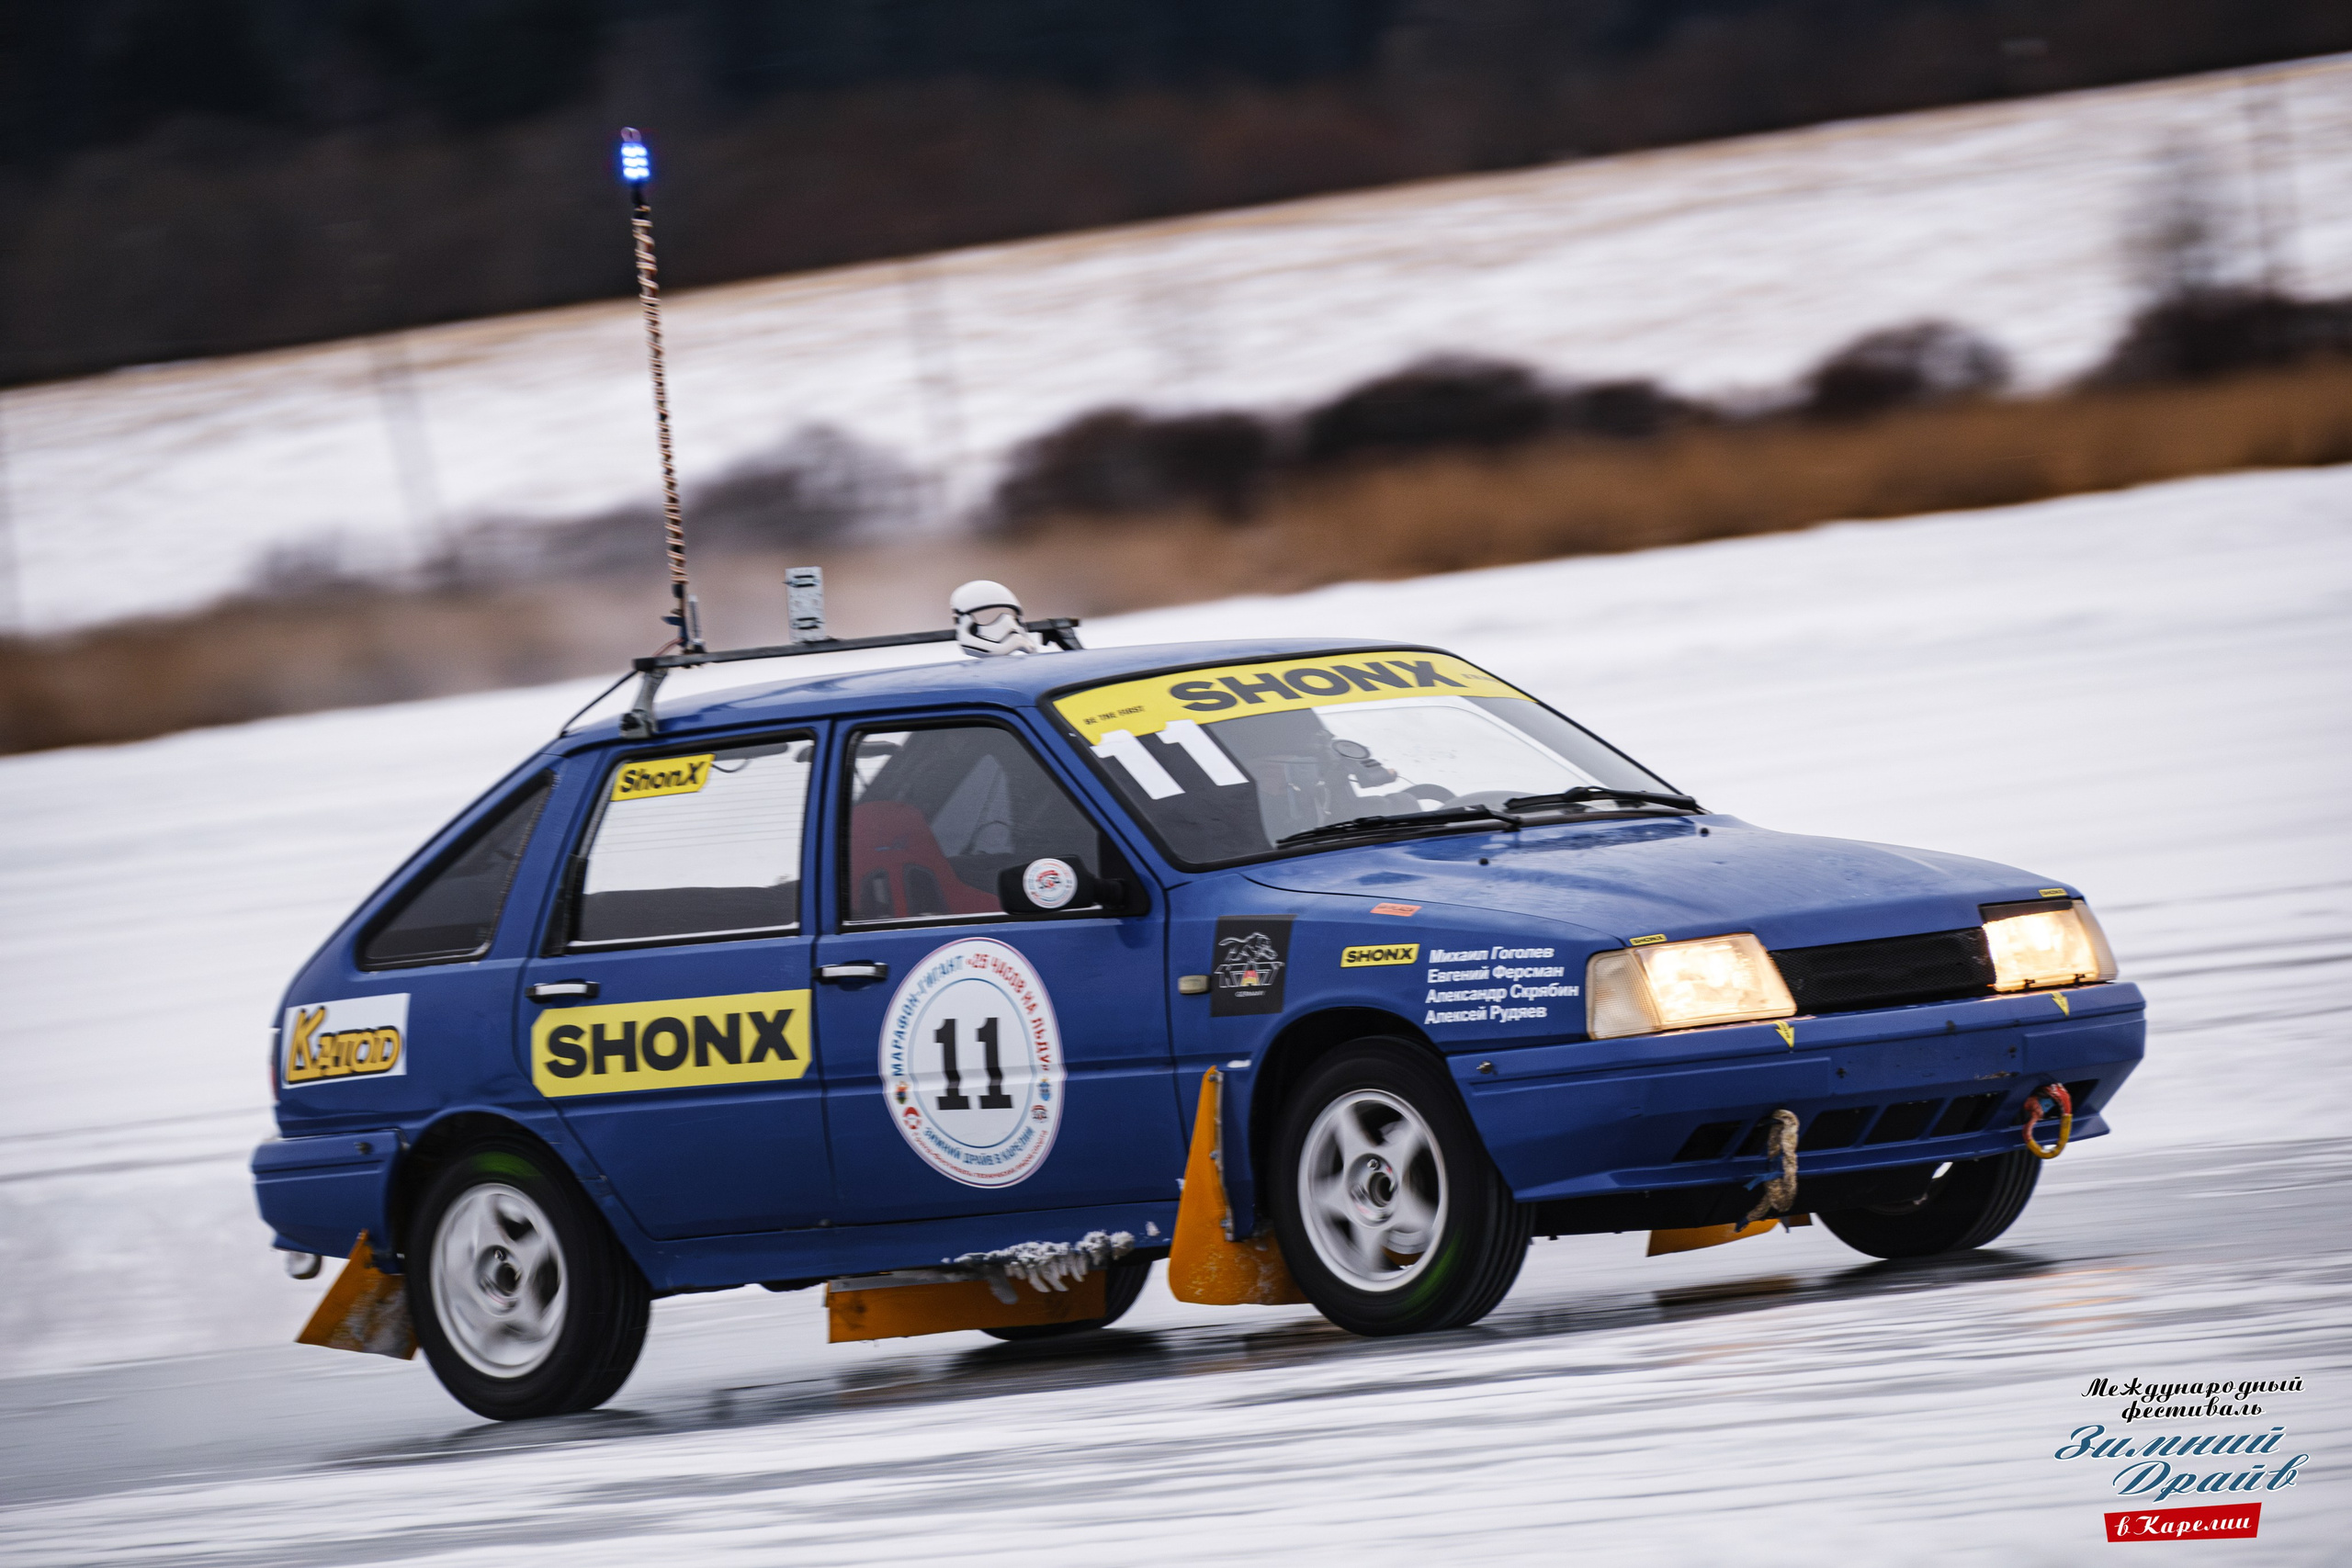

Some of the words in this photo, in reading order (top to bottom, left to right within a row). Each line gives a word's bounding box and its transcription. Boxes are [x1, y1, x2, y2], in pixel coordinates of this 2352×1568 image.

[1170, 660, 1469, 713] SHONX
[1091, 719, 1250, 800] 11
[620, 761, 707, 793] ShonX
[1346, 947, 1413, 964] SHONX
[1429, 949, 1488, 964] Михаил
[1490, 946, 1555, 960] Гоголев
[1427, 965, 1490, 983] Евгений
[1492, 965, 1565, 981] Ферсман
[1425, 987, 1508, 1003] Александр
[1510, 983, 1579, 1001] Скрябин
[1424, 1006, 1487, 1024] Алексей
[1489, 1005, 1547, 1023] Рудяев
[544, 1008, 797, 1080] SHONX
[933, 1017, 1013, 1111] 11
